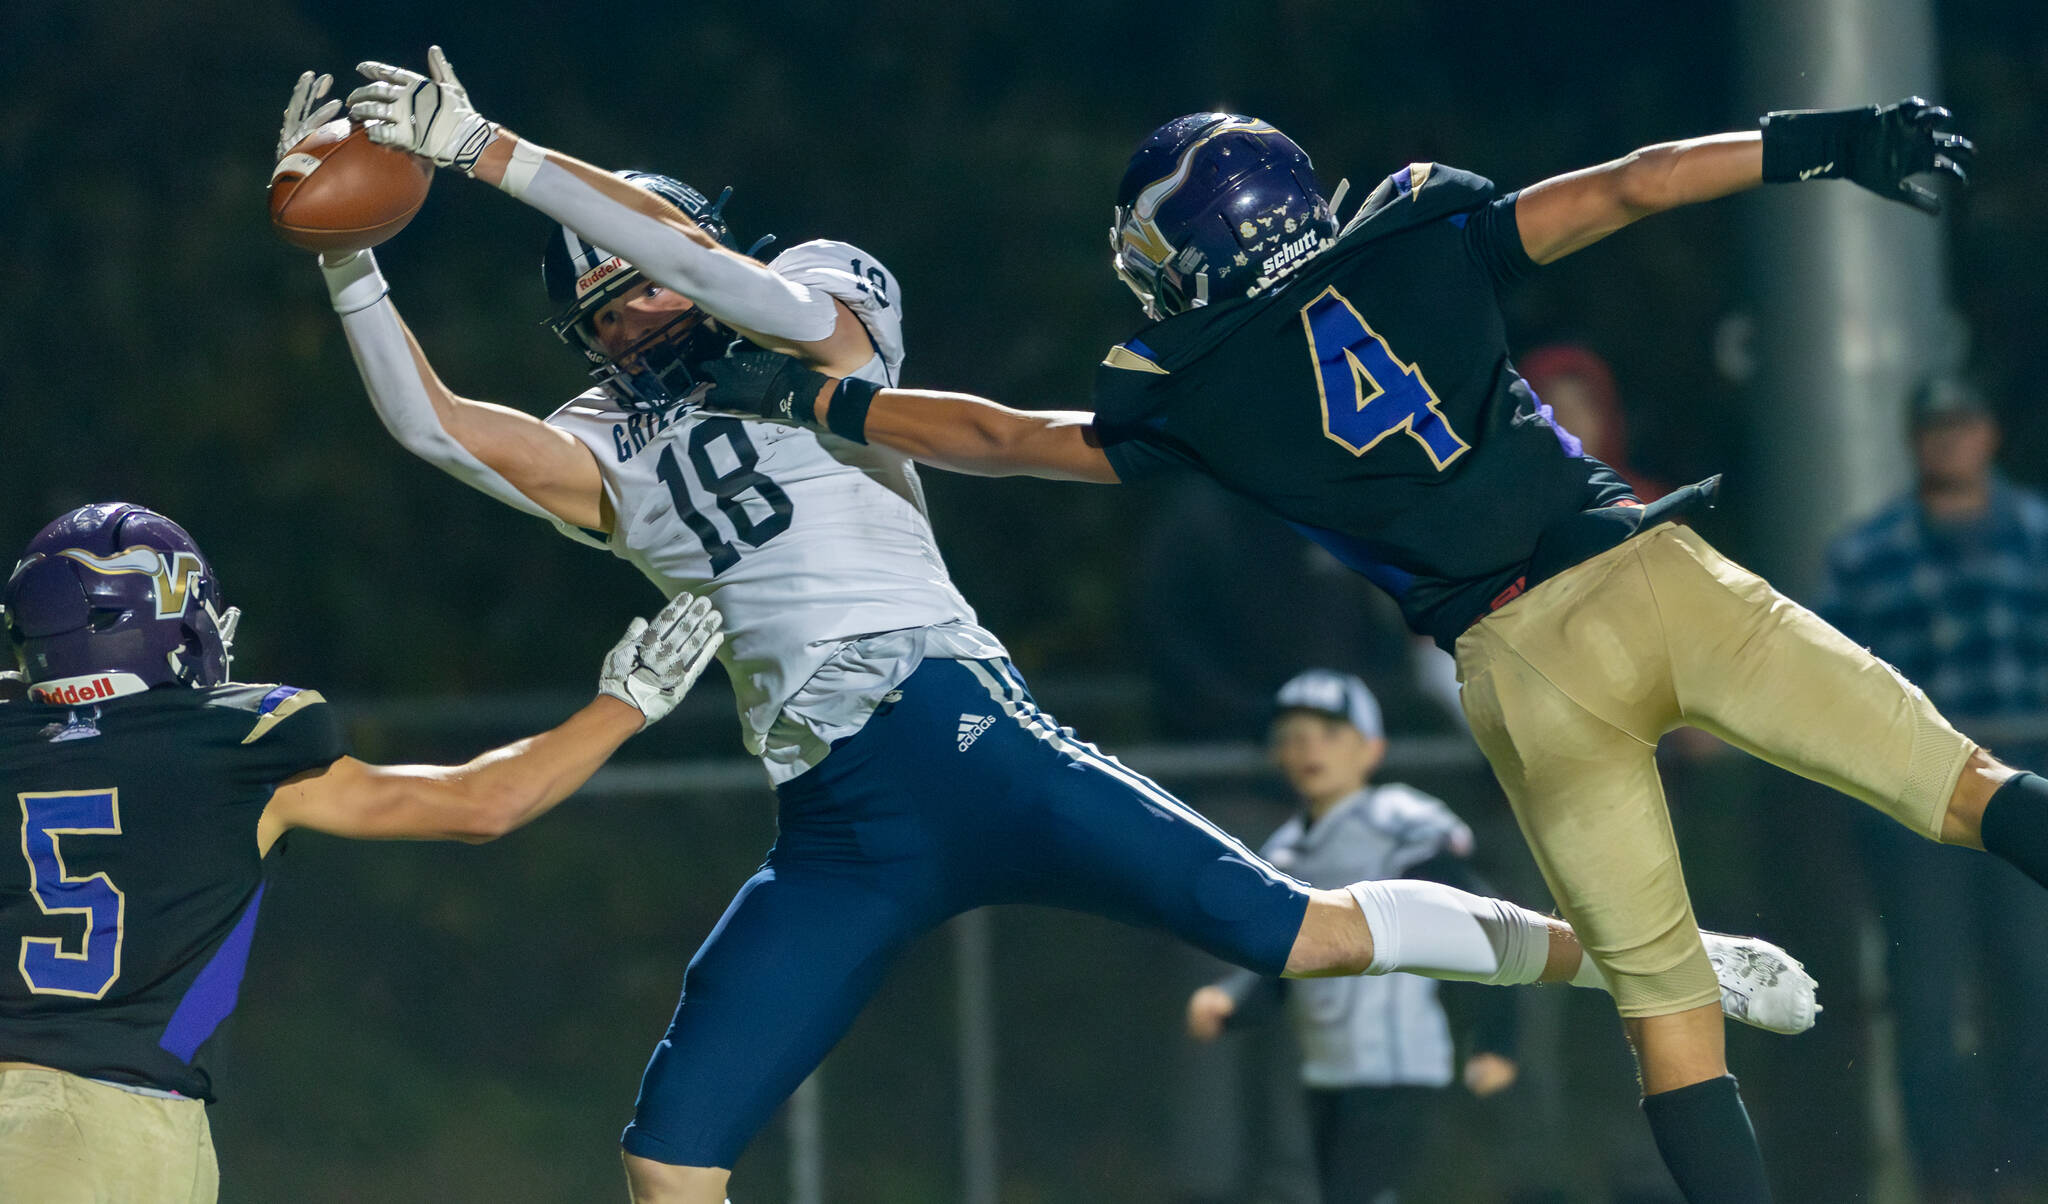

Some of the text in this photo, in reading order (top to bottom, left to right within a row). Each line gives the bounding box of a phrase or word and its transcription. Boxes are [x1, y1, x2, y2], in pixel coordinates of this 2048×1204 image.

[578, 256, 622, 290] Riddell
[1262, 228, 1318, 276] schutt
[1300, 284, 1472, 472] 4
[655, 416, 794, 578] 18
[34, 677, 115, 705] ddell
[958, 714, 997, 753] adidas
[17, 787, 125, 1001] 5
